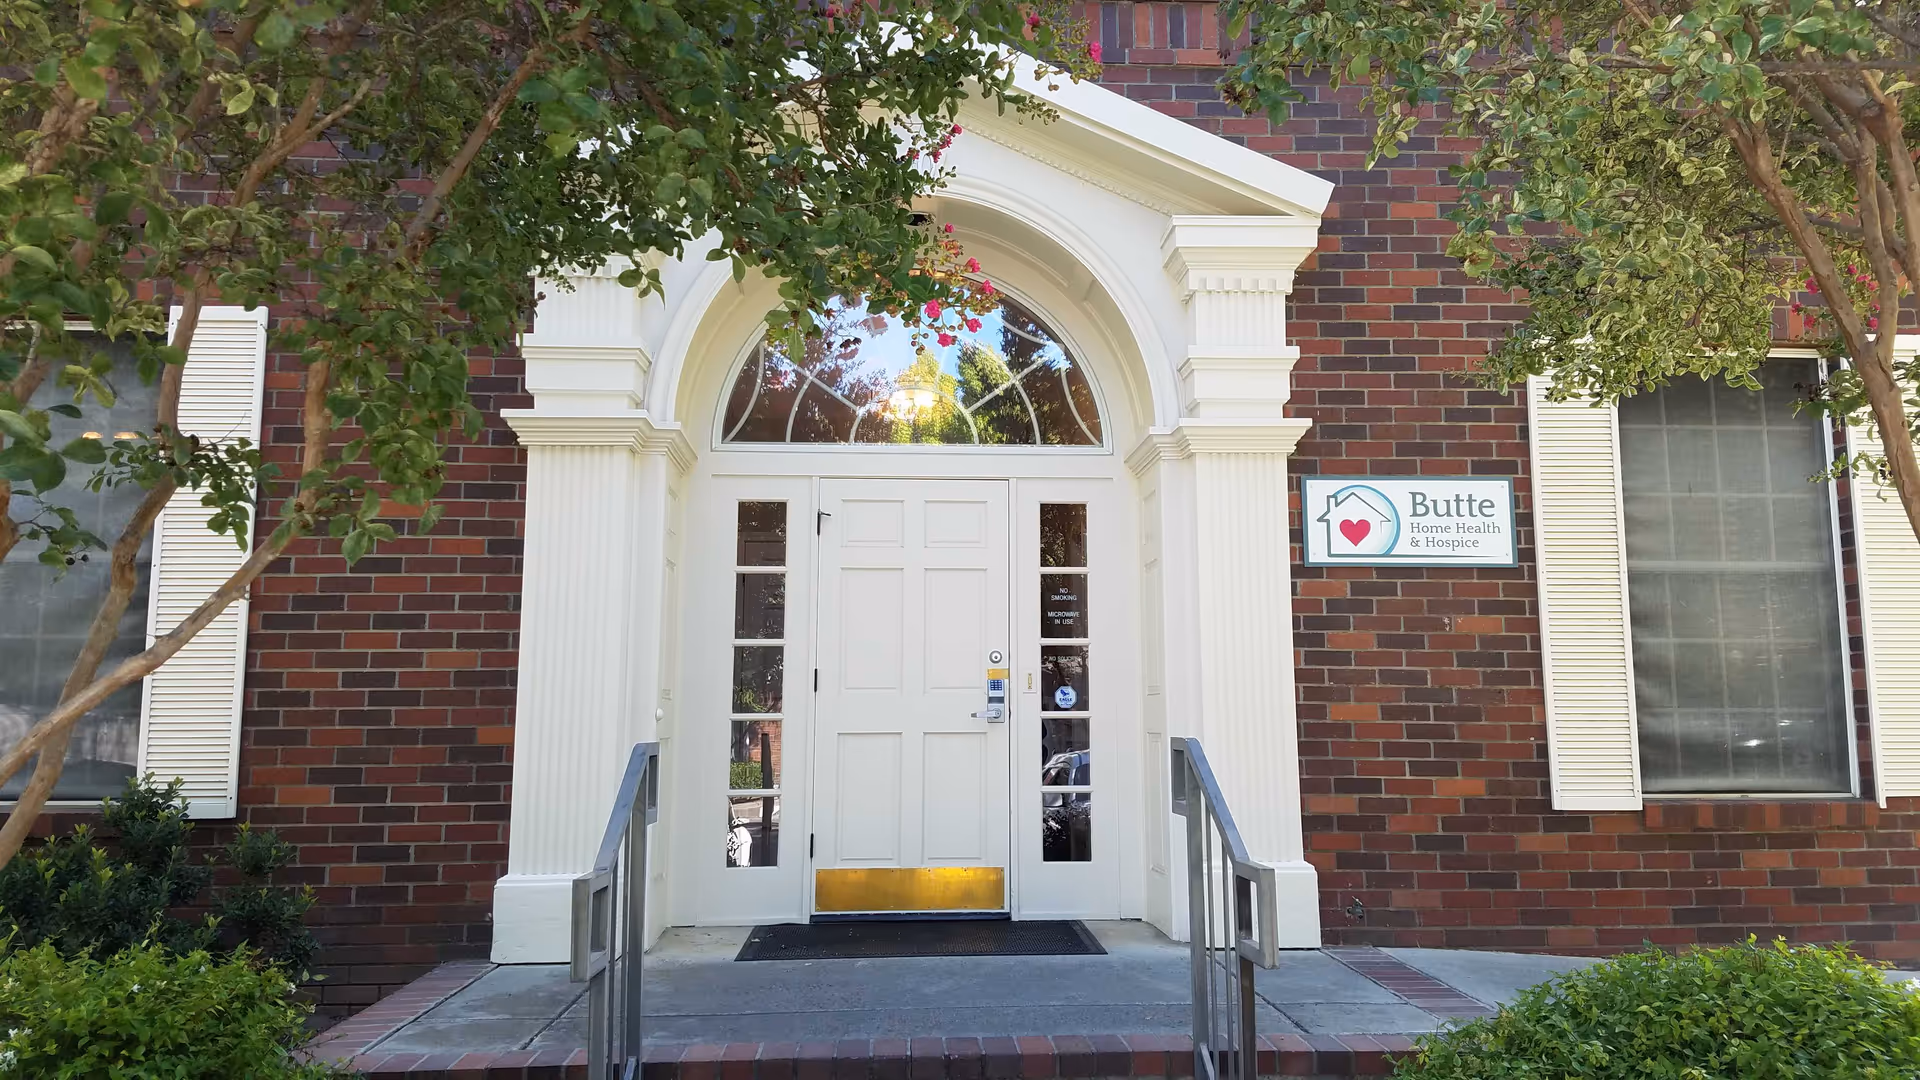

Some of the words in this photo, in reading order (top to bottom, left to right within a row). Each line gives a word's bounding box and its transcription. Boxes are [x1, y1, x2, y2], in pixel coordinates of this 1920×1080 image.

[1408, 491, 1496, 518] Butte
[1410, 522, 1452, 534] Home
[1456, 521, 1501, 534] Health
[1410, 536, 1421, 548] &
[1425, 536, 1480, 552] Hospice
